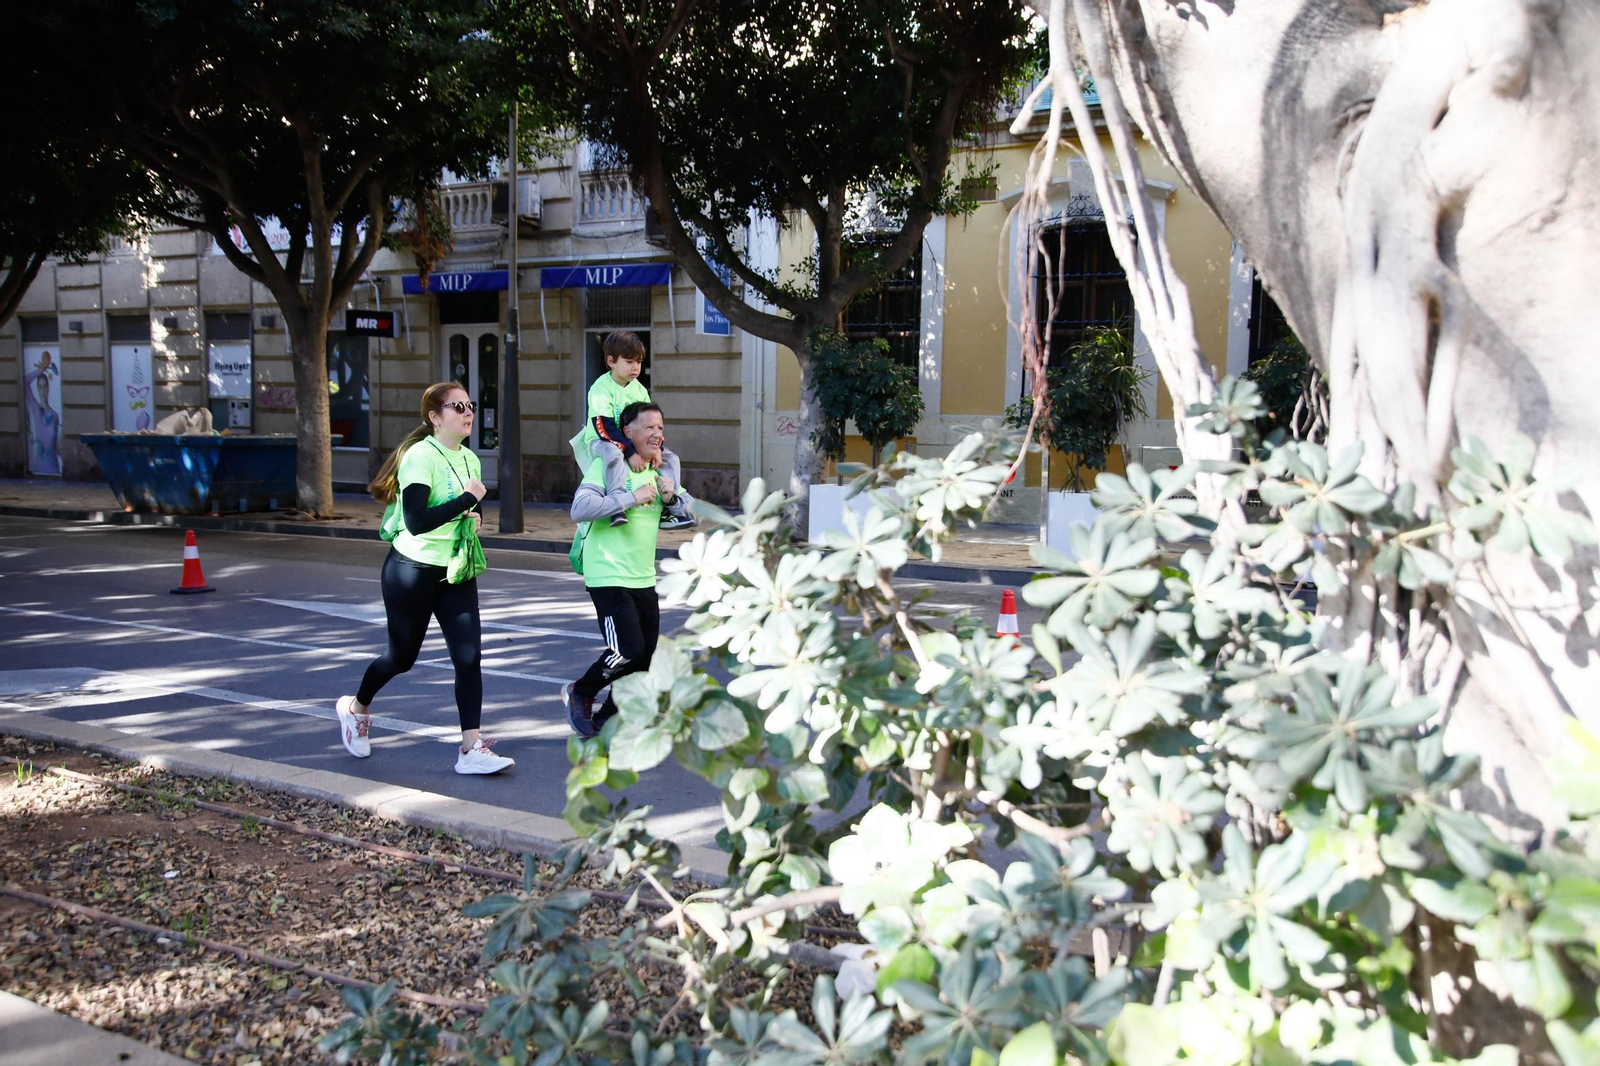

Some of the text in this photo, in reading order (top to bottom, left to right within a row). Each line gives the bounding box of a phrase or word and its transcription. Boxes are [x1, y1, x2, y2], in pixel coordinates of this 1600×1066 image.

[440, 274, 472, 291] MLP
[585, 267, 623, 286] MLP
[355, 317, 392, 330] MRW
[233, 361, 250, 372] tiger
